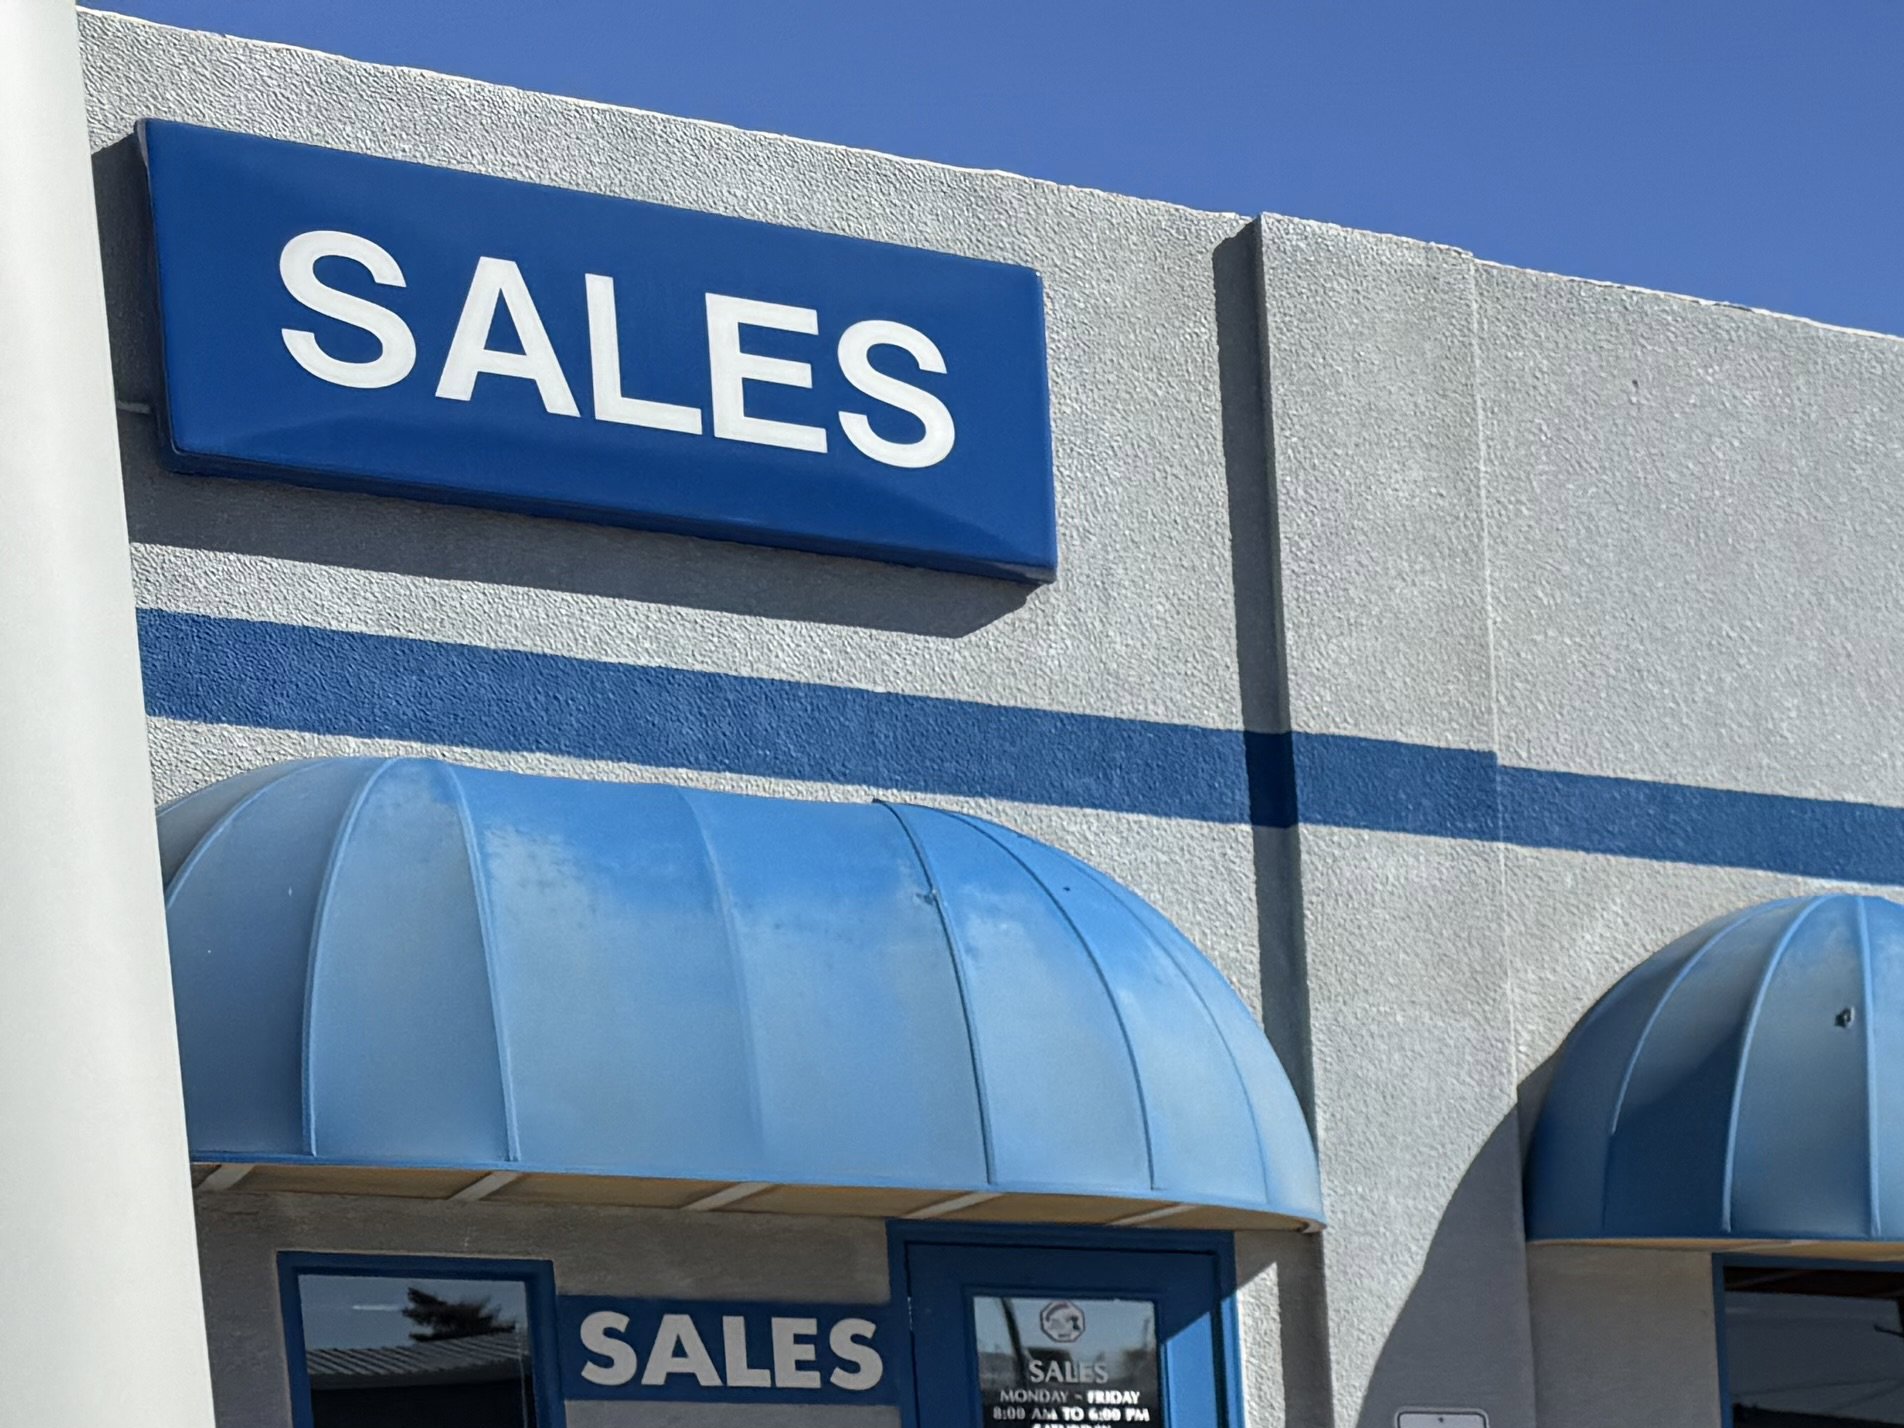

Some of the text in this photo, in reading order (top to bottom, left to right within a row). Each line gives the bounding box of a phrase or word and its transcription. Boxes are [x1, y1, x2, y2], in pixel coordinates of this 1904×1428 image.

[279, 229, 957, 468] SALES
[579, 1310, 884, 1391] SALES
[1029, 1360, 1109, 1384] SALES
[1000, 1389, 1069, 1403] MONDAY
[1087, 1390, 1140, 1405] FRIDAY
[993, 1406, 1026, 1420] 8:00
[1032, 1407, 1058, 1421] AM
[1062, 1406, 1085, 1421] TO
[1125, 1408, 1150, 1422] PM
